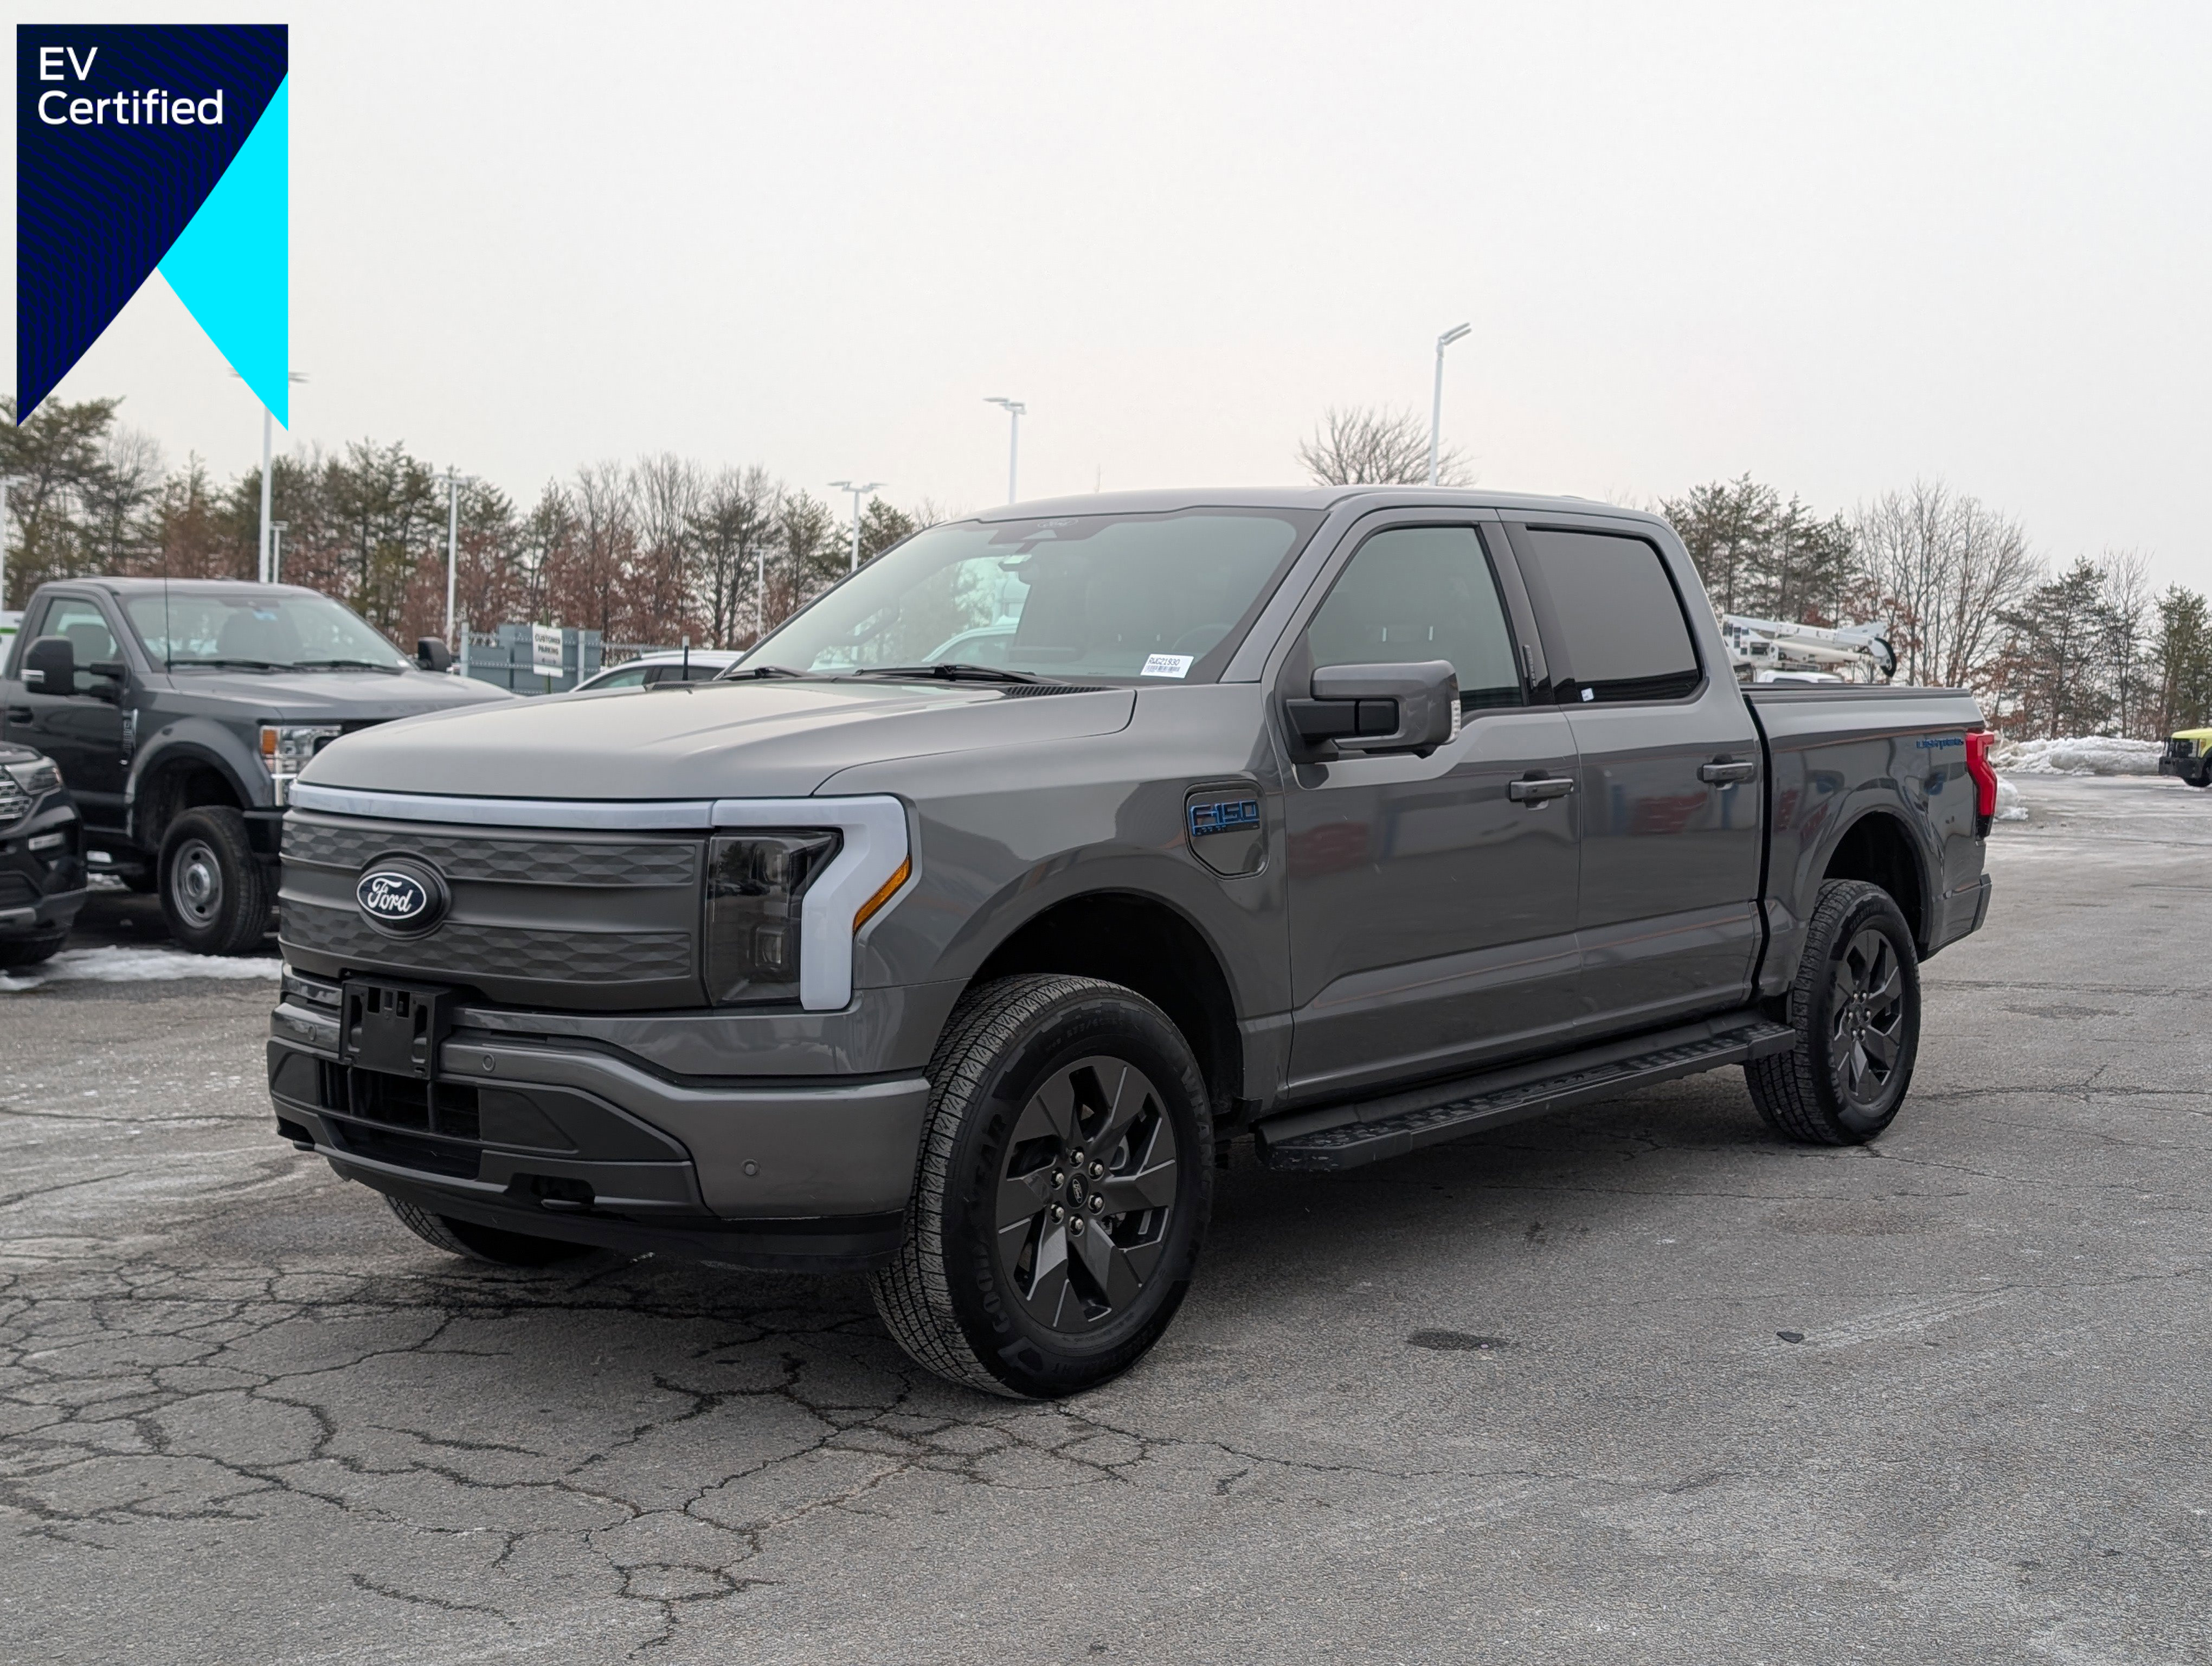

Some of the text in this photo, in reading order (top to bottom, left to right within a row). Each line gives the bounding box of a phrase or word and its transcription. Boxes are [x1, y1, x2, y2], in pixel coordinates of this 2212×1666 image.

[535, 633, 560, 644] CUSTOMER
[538, 644, 558, 655] PARKING
[368, 877, 414, 912] Ford
[972, 1113, 1011, 1334] GOODEAR
